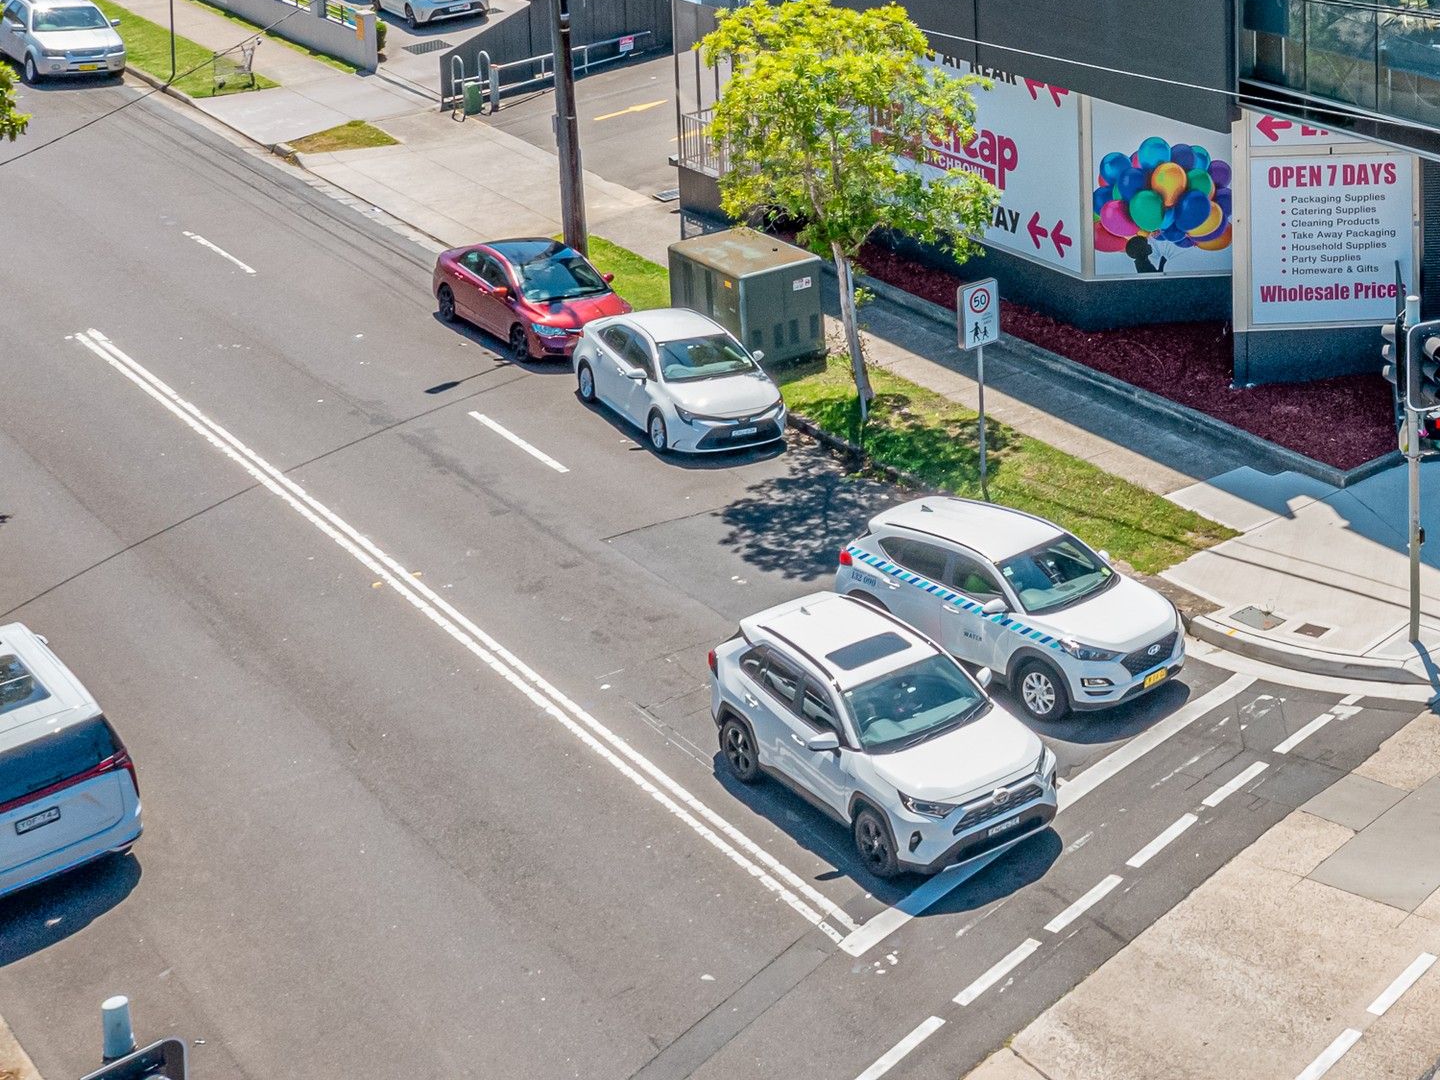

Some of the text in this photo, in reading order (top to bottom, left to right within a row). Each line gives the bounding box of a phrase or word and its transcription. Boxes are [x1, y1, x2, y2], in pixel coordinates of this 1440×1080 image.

[1268, 162, 1397, 189] OPEN 7 DAYS
[1291, 193, 1386, 205] Packaging Supplies
[1291, 205, 1377, 217] Catering Supplies
[992, 206, 1020, 234] AY
[1291, 217, 1380, 229] Cleaning Products
[1291, 228, 1396, 241] Take Away Packaging
[1291, 240, 1387, 252] Household Supplies
[1291, 253, 1362, 264] Party Supplies
[1291, 264, 1379, 275] Homeware & Gifts
[1260, 281, 1407, 303] Wholesale Prices
[974, 294, 986, 308] 50
